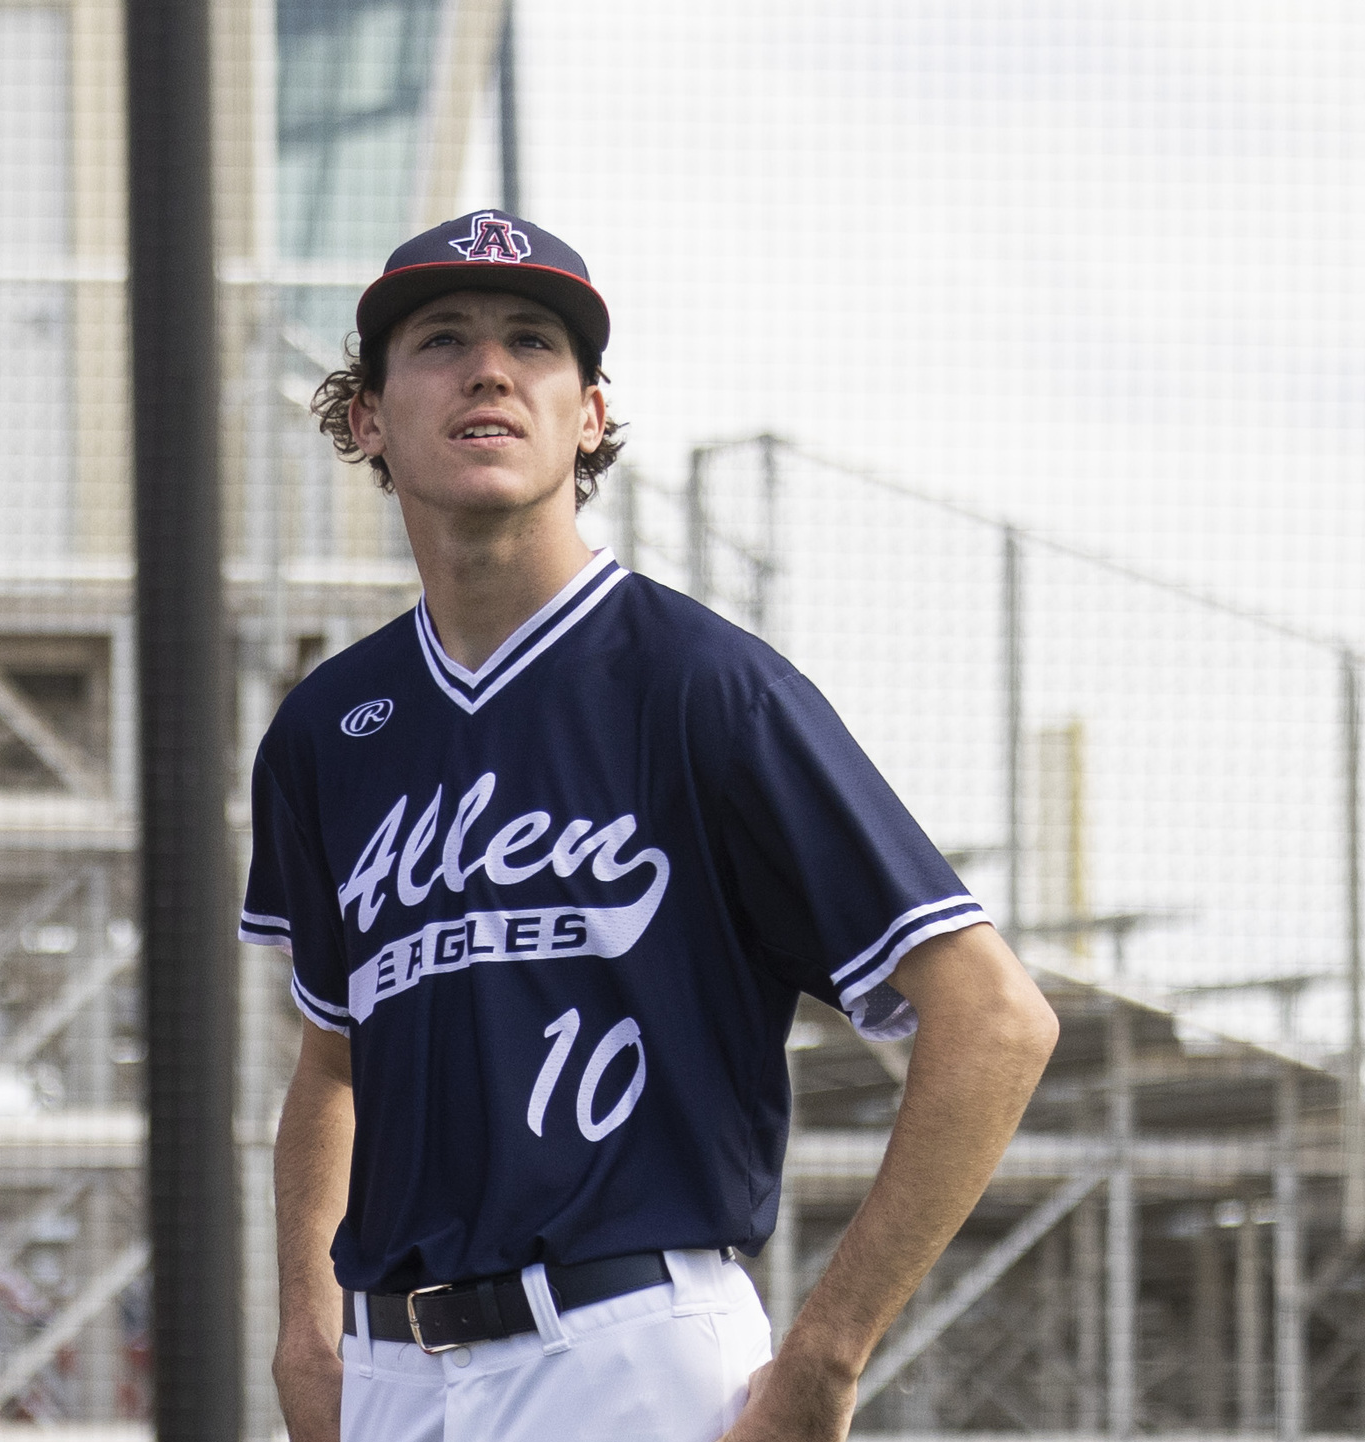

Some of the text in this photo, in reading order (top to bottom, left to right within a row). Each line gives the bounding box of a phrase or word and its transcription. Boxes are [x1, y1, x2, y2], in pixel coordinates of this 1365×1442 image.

[338, 772, 669, 932] Allen
[375, 912, 588, 994] EAGLES
[527, 1007, 647, 1142] 10
